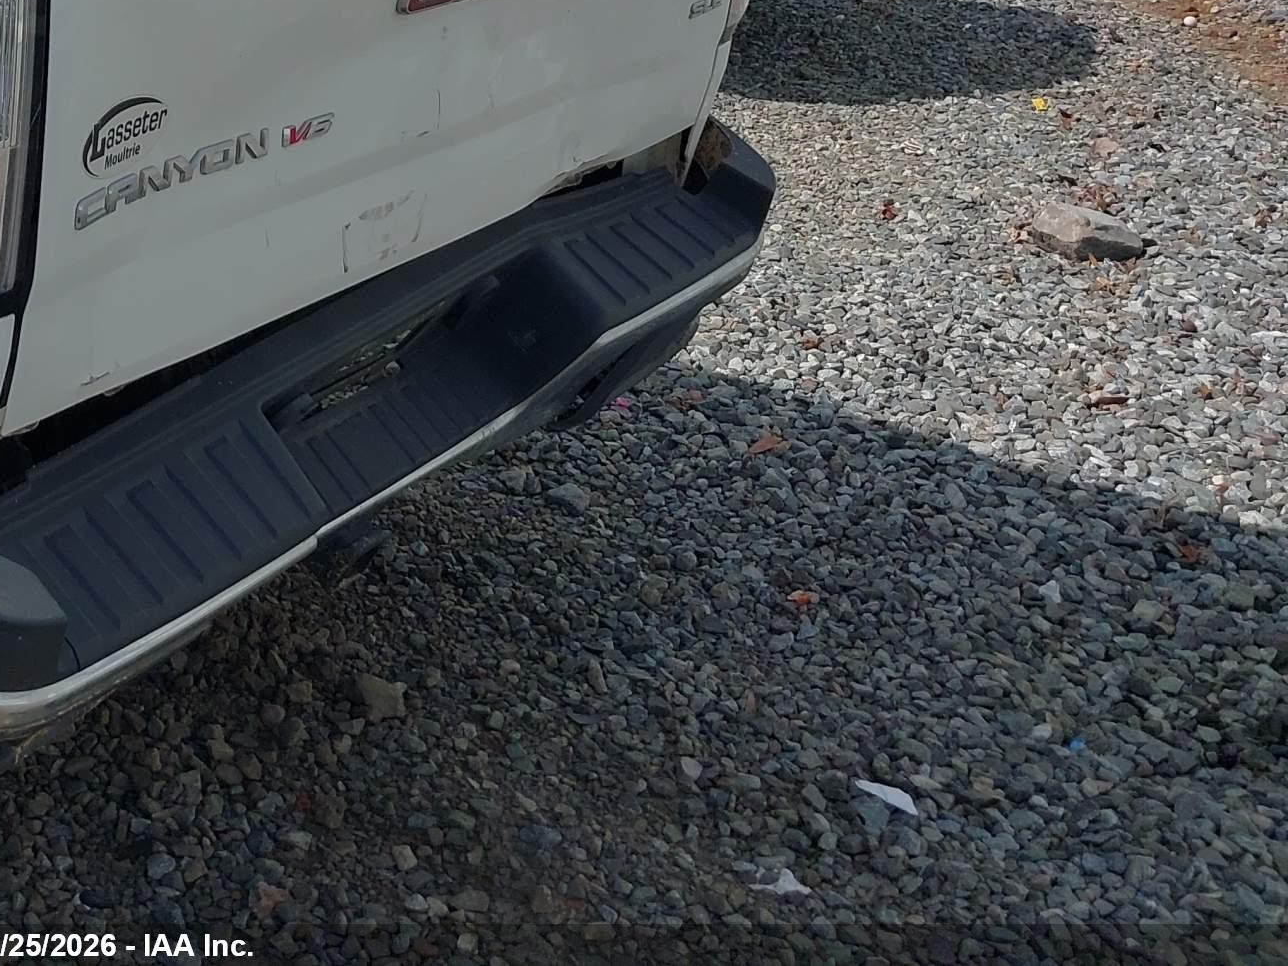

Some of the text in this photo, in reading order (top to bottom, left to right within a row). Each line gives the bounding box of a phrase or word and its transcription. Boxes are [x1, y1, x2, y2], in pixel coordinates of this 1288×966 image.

[89, 108, 168, 163] Lasseter
[104, 142, 141, 171] Moultrie
[73, 112, 335, 231] CANYON V6
